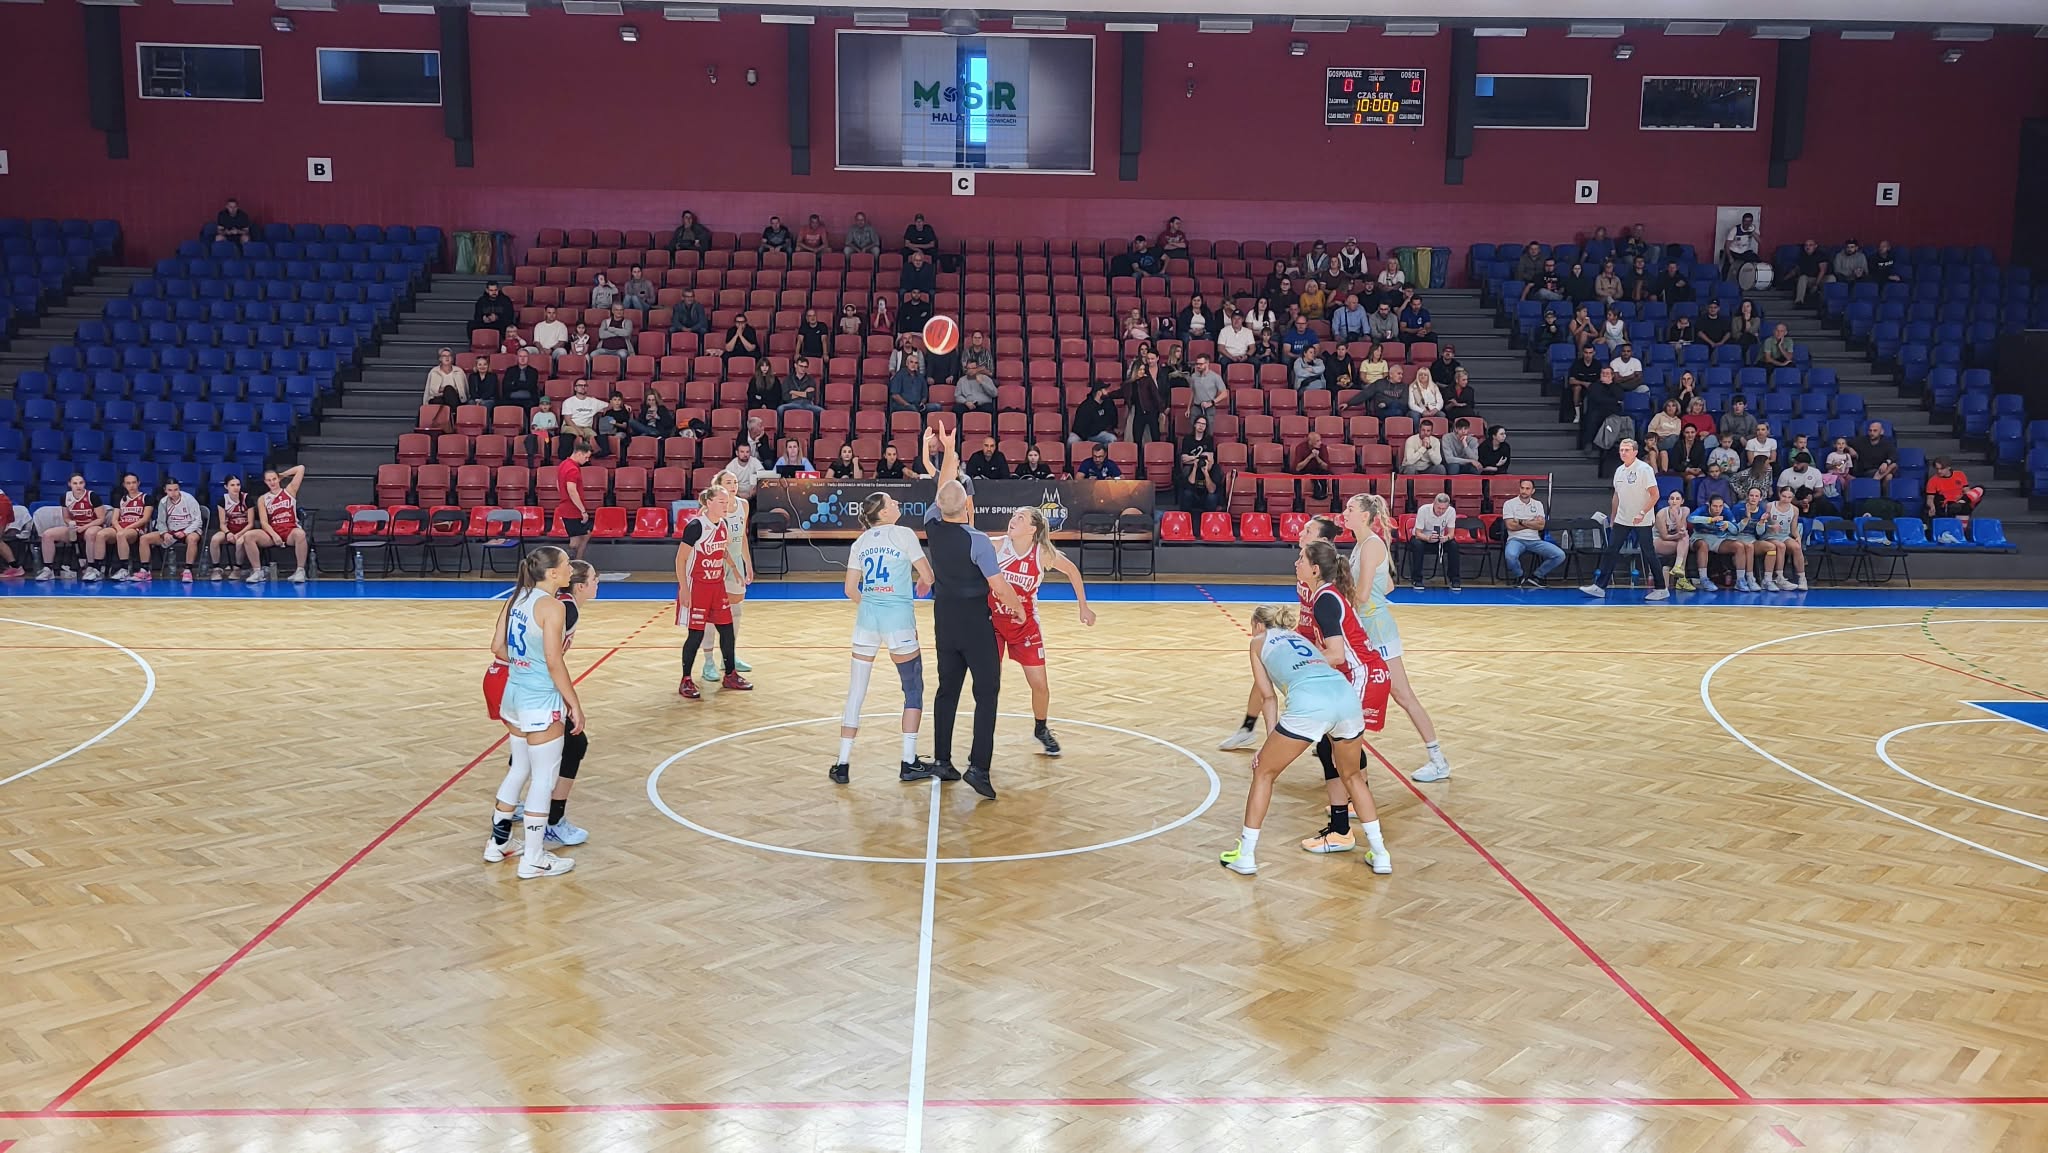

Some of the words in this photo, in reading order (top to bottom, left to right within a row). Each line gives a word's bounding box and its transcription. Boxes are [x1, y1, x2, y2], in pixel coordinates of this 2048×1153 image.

[1328, 70, 1362, 78] GOSPODARZE
[1343, 79, 1354, 92] 0
[1411, 79, 1421, 93] 0
[1357, 91, 1377, 99] CZAS
[313, 163, 326, 176] B
[957, 177, 969, 191] C
[1581, 185, 1593, 198] D
[1882, 188, 1894, 201] E
[974, 506, 990, 514] LNY
[731, 523, 739, 532] 13
[864, 555, 890, 585] 24
[508, 618, 527, 657] 43
[1287, 639, 1313, 657] 5
[1379, 645, 1389, 658] 11
